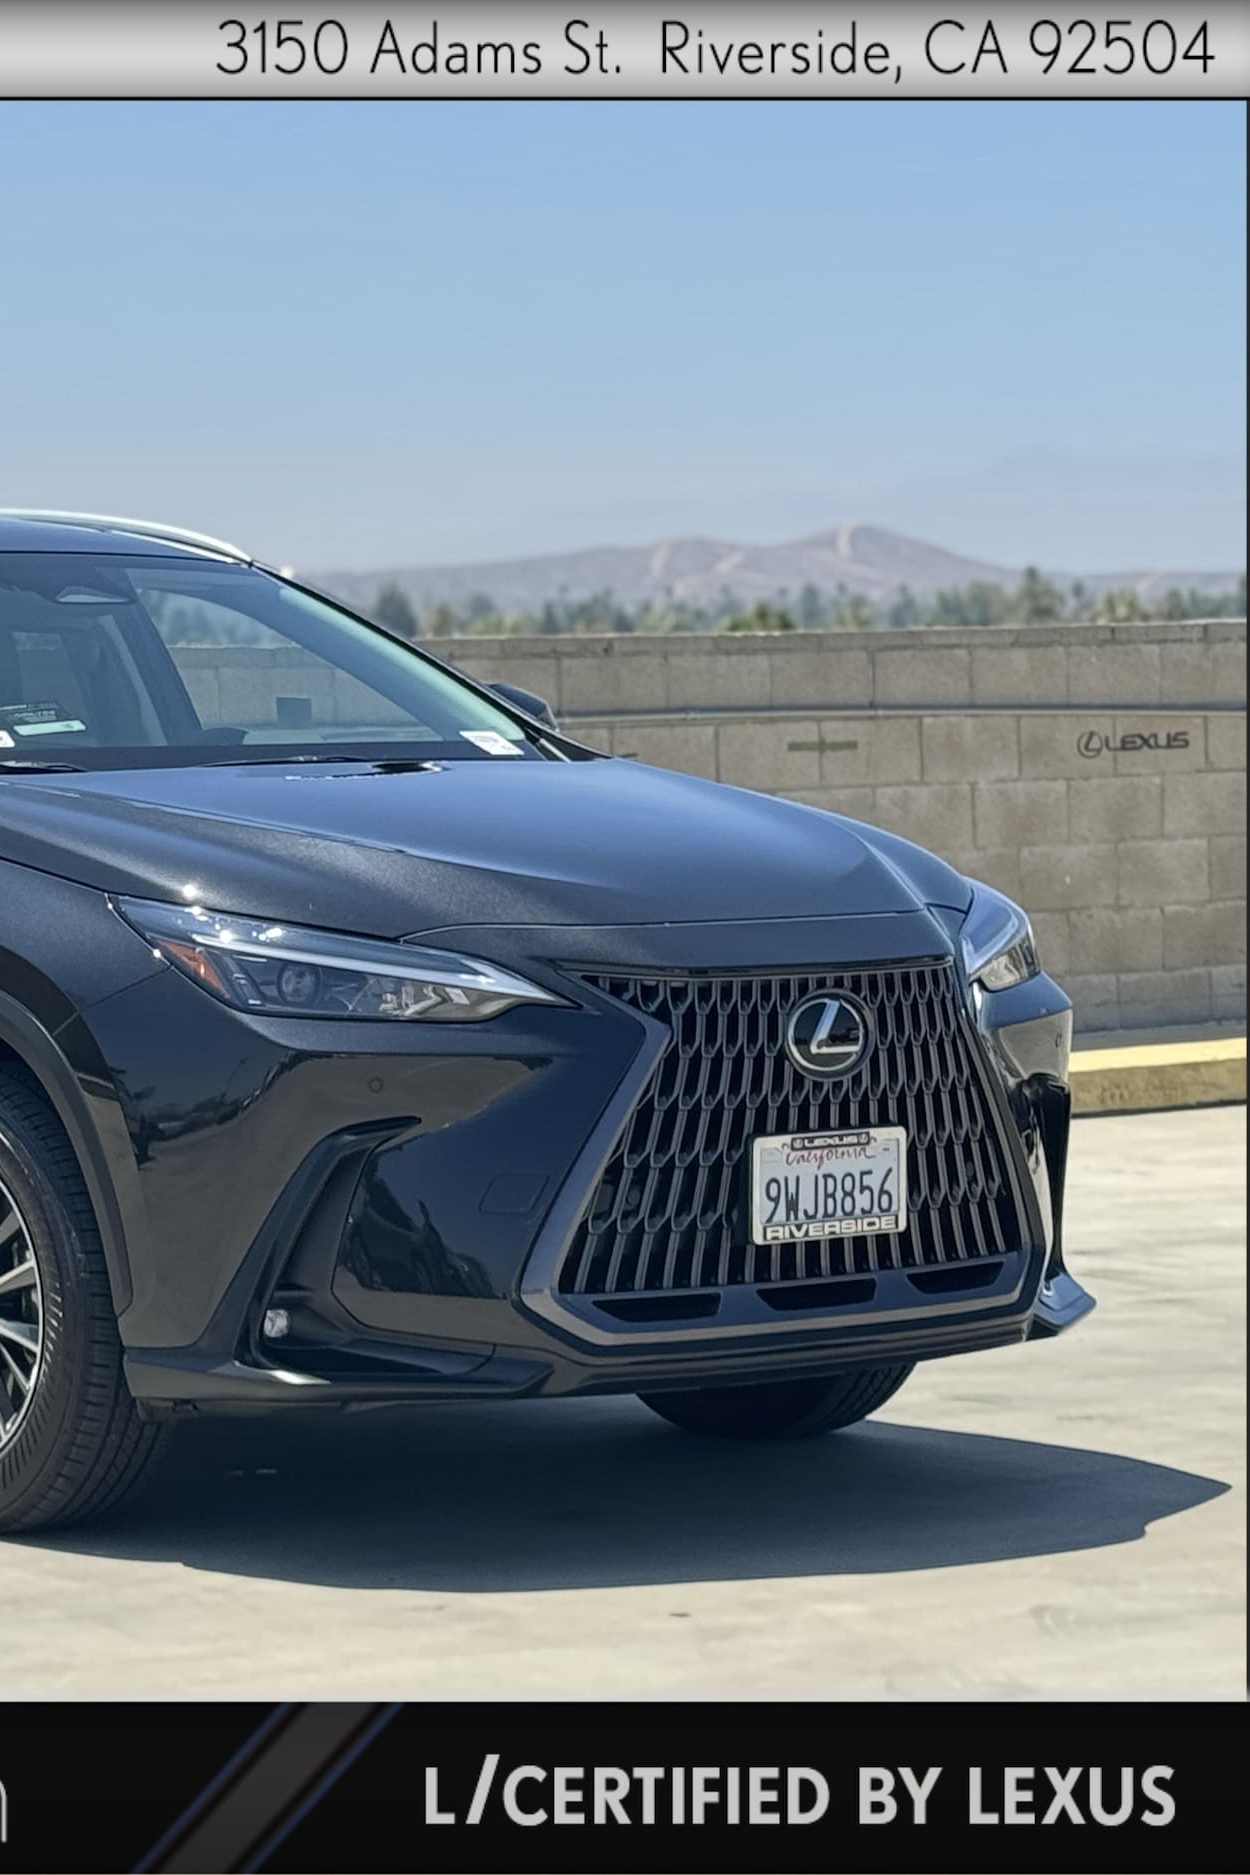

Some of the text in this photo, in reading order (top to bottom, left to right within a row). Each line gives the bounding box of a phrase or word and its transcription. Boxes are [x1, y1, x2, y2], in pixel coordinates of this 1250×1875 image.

[1105, 731, 1190, 751] LEXUS
[804, 1134, 858, 1147] LEXUS
[764, 1167, 893, 1224] 9WJB856
[766, 1215, 897, 1241] RIVERSIDE
